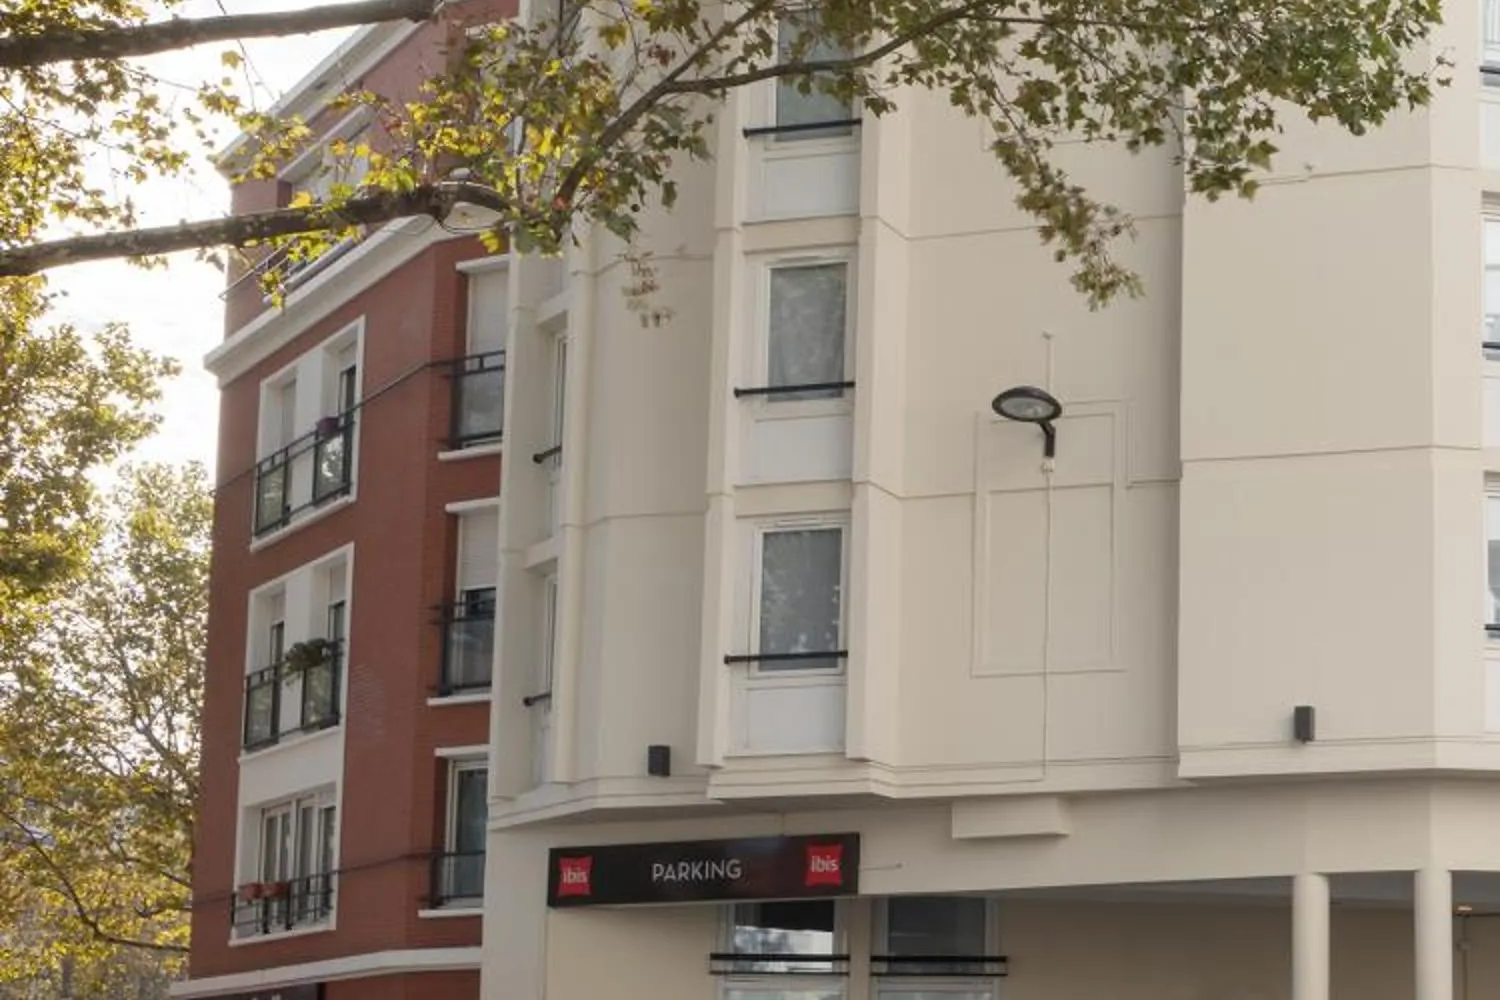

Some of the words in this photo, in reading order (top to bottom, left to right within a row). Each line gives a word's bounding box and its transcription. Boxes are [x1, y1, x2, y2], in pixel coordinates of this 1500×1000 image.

[652, 858, 743, 882] PARKING
[811, 854, 839, 873] ibis
[562, 866, 588, 884] ibis
